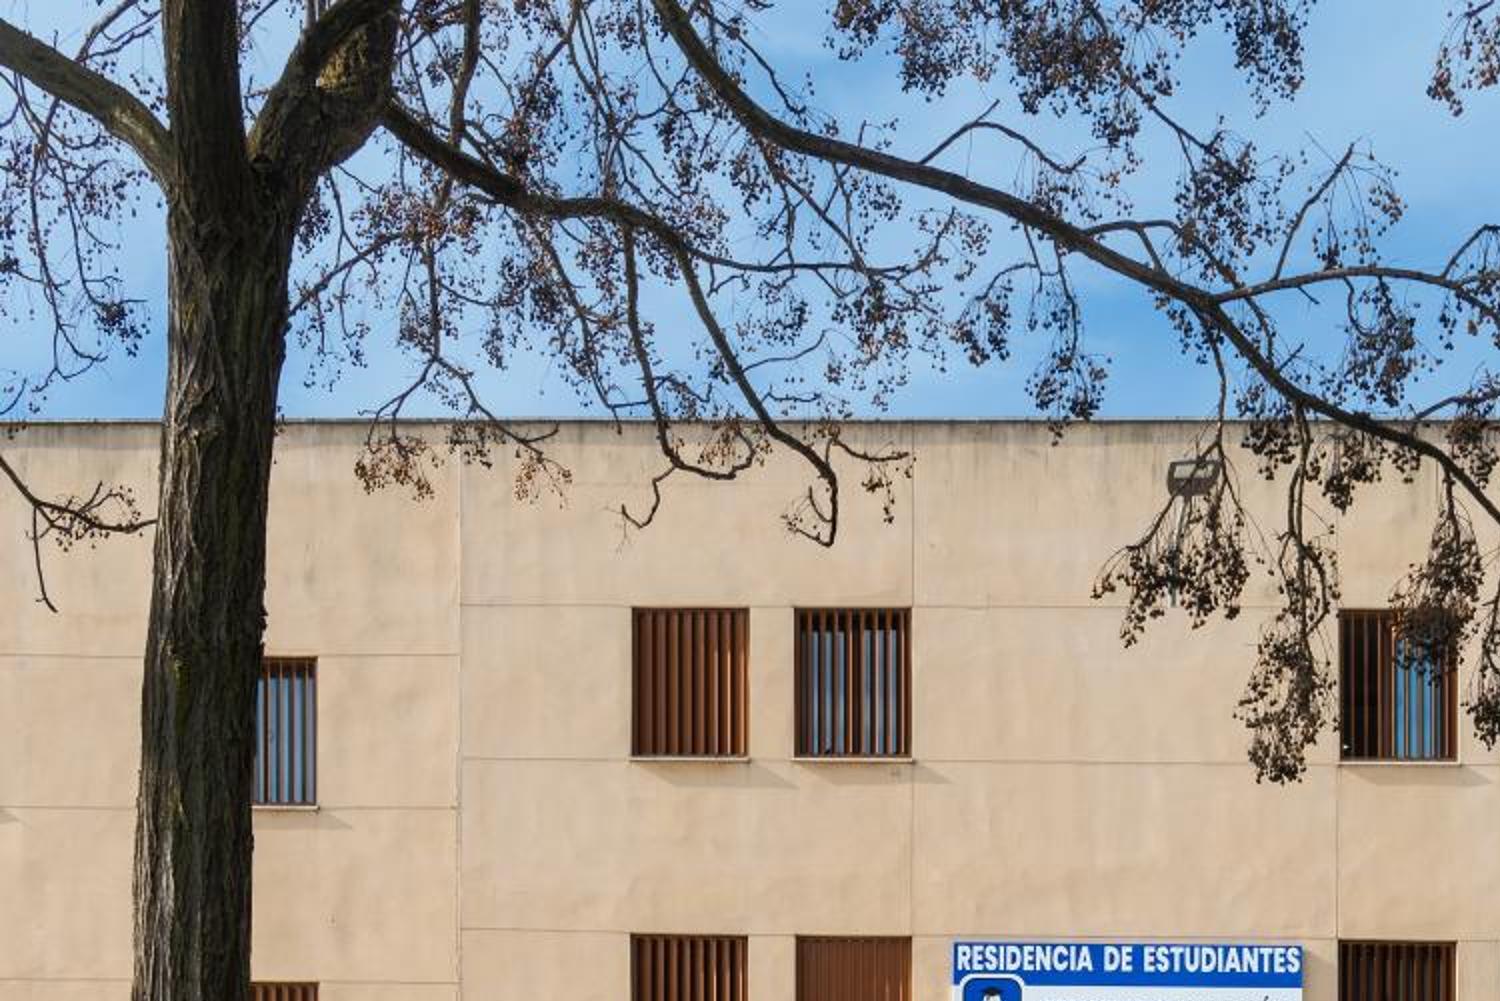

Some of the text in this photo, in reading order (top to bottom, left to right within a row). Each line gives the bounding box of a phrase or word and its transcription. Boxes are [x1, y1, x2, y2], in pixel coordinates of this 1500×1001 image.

[957, 945, 1301, 973] RESIDENCIA DE ESTUDIANTES
